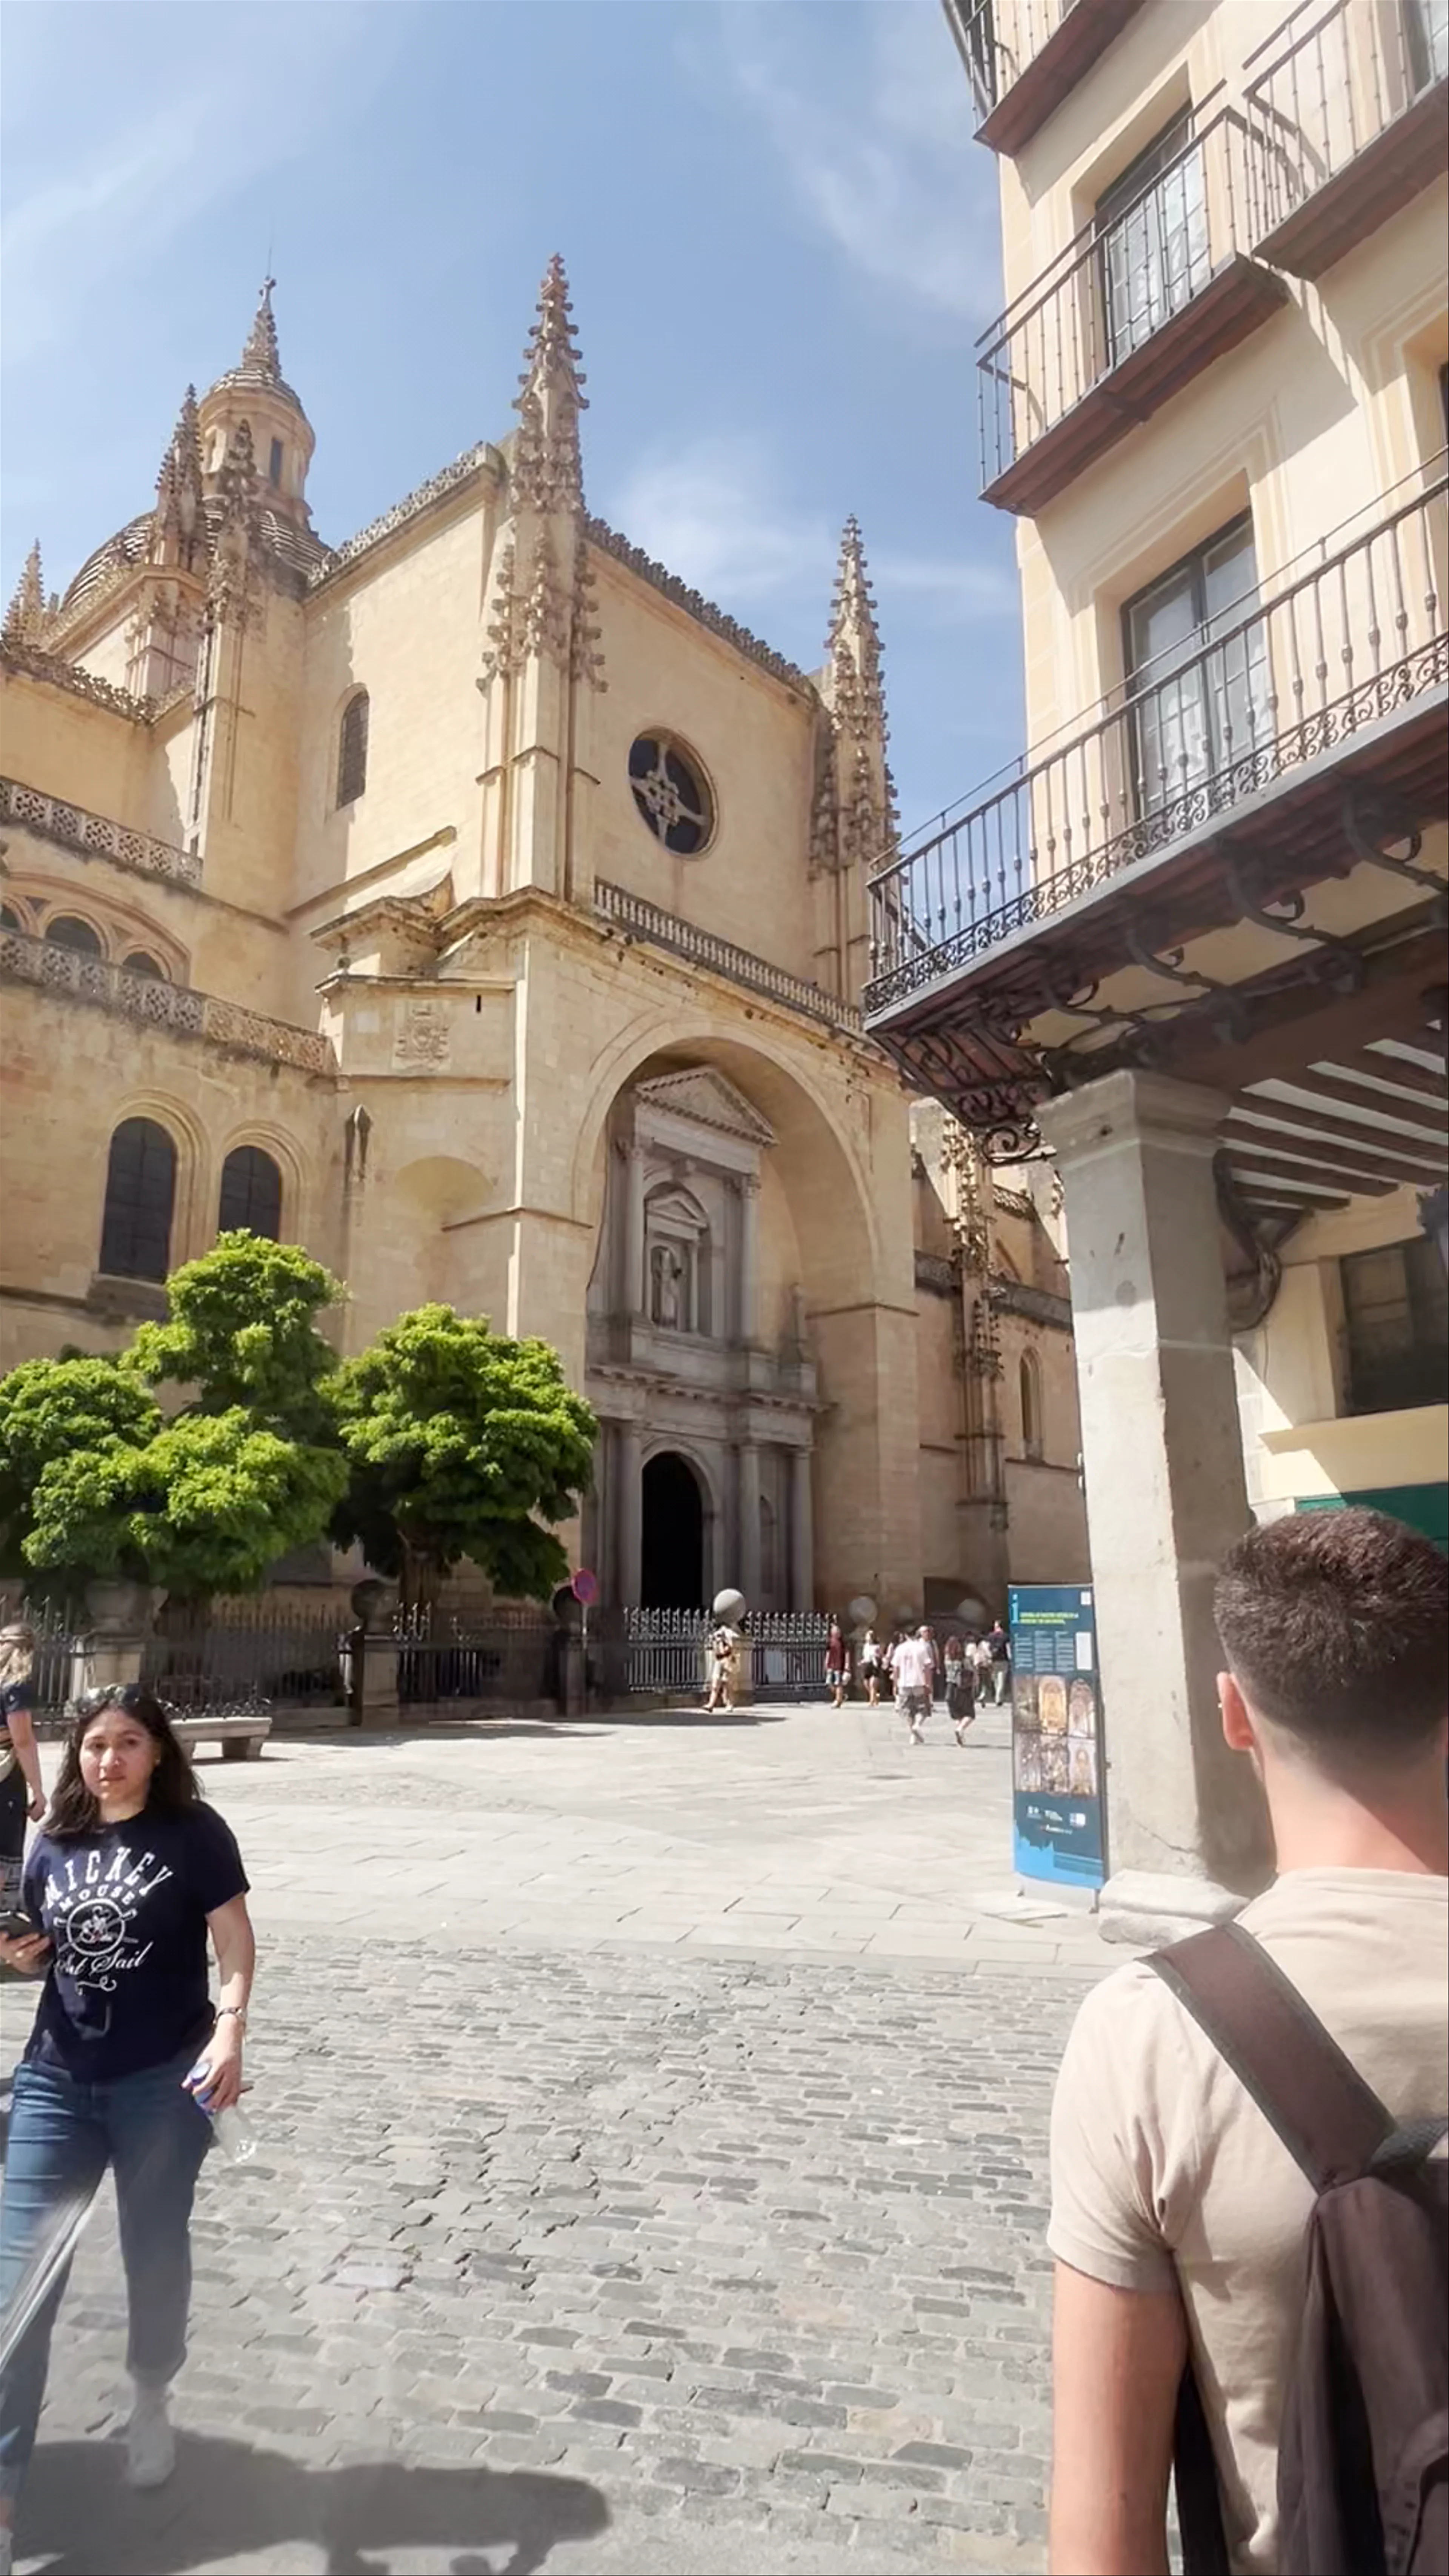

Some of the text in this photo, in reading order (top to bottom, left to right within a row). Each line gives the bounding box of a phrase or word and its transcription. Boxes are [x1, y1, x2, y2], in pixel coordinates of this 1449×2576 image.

[45, 1846, 173, 1910] MICKEY
[59, 1884, 135, 1912] MOUSE
[88, 1942, 153, 1976] Sail
